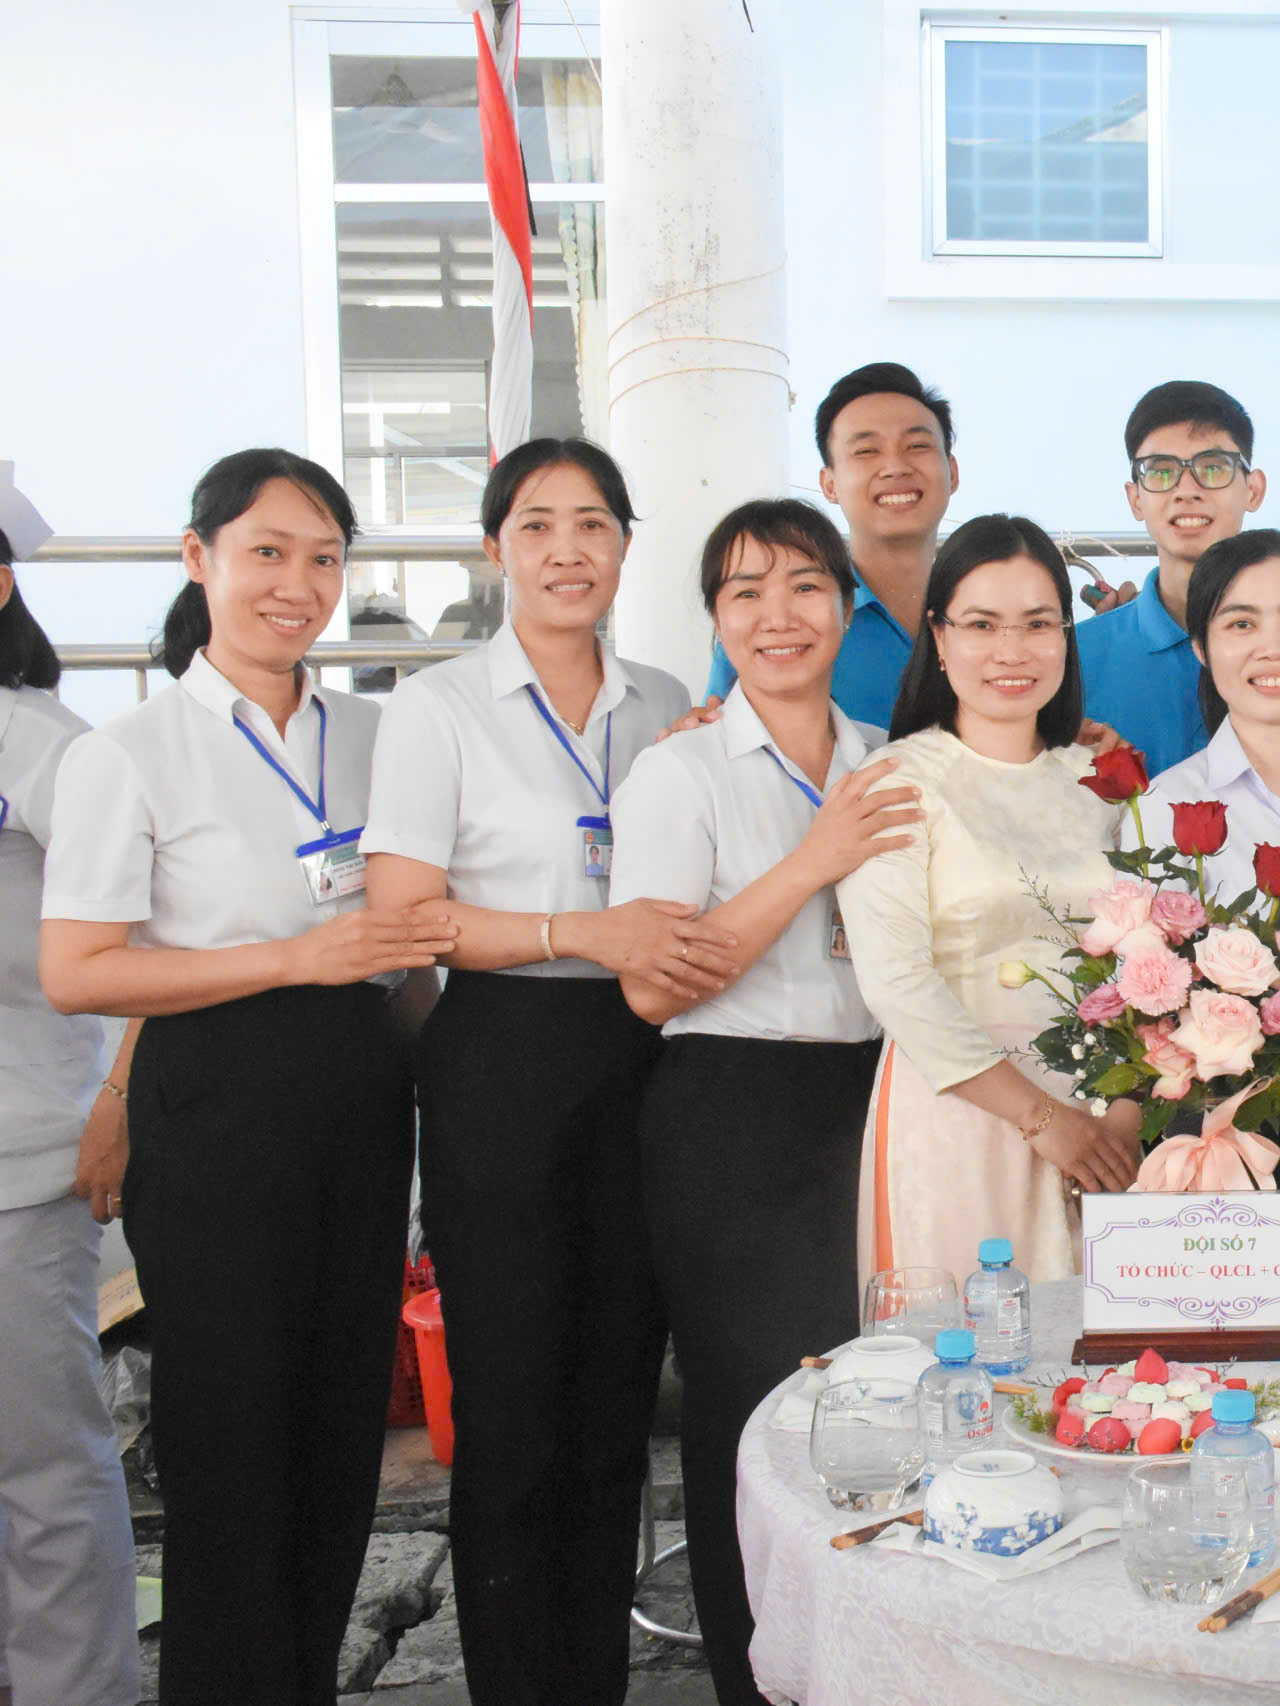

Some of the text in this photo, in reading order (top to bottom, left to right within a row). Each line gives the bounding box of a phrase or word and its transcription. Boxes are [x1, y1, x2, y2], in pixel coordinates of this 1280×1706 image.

[1184, 1234, 1256, 1254] ĐỘI SỐ 7
[1145, 1261, 1193, 1278] CHỨC
[1210, 1264, 1256, 1280] QLCL
[1260, 1266, 1269, 1276] +
